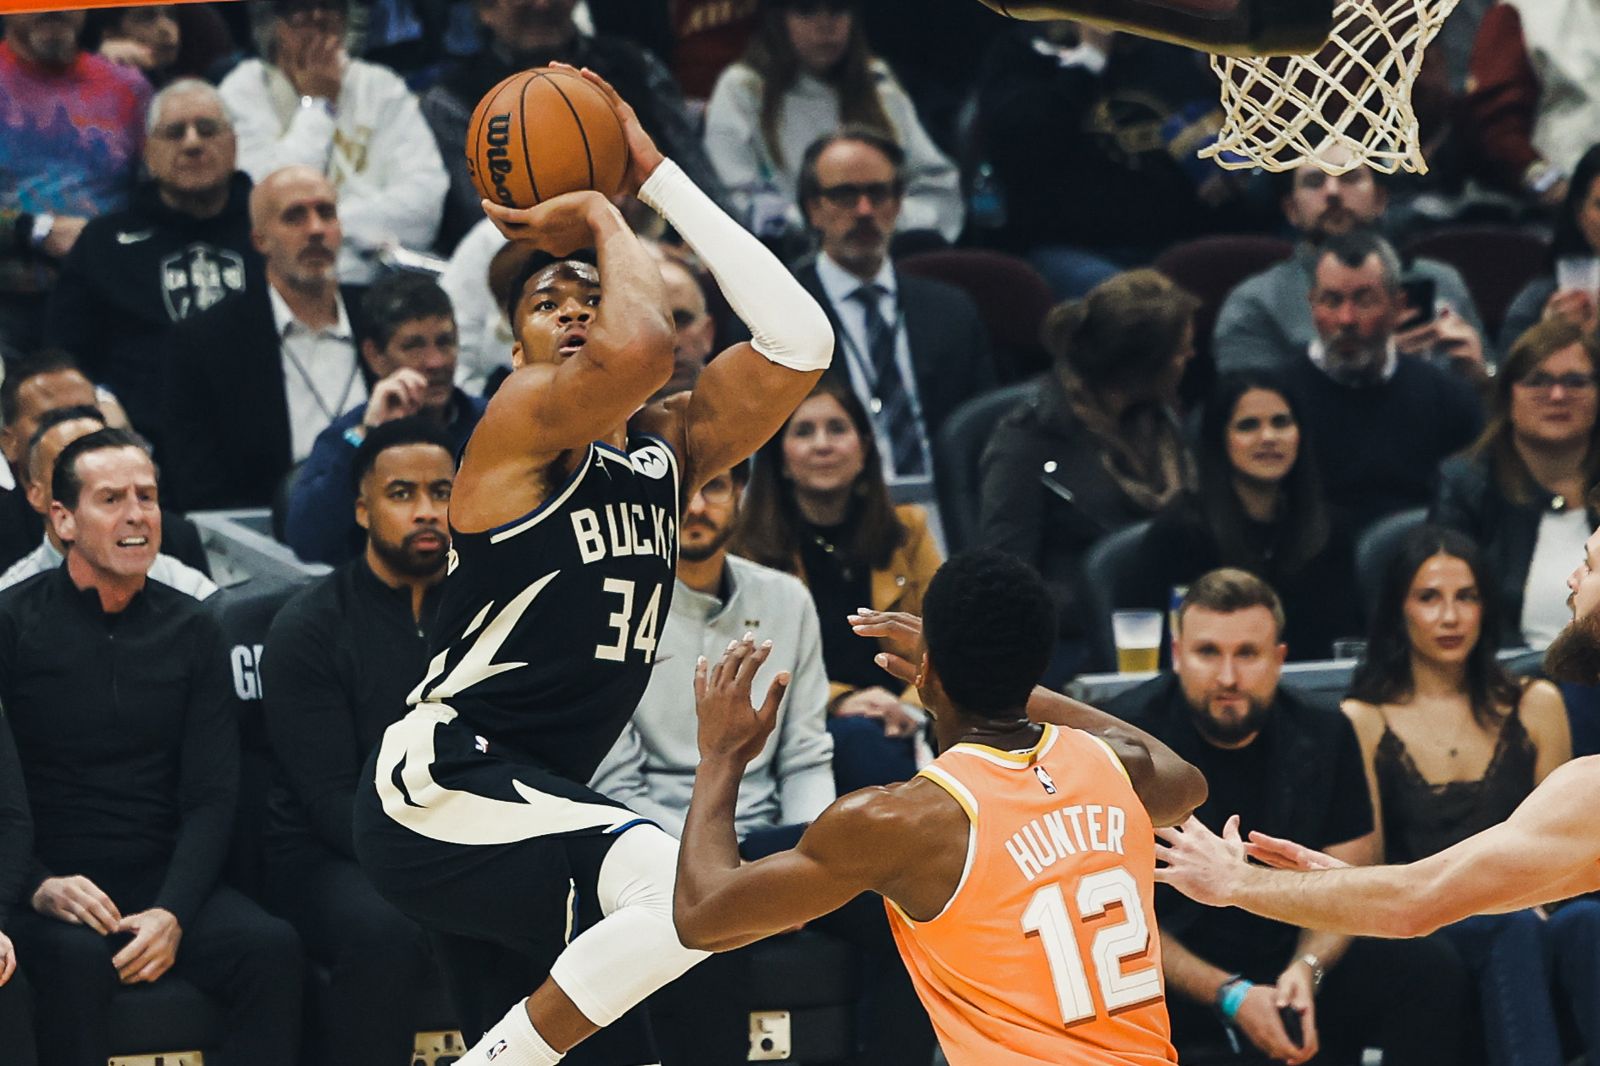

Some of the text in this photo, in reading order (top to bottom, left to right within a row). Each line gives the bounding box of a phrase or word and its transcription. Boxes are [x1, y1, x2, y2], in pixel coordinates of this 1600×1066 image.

[487, 112, 517, 208] Wilso
[594, 577, 663, 664] 34
[1004, 804, 1125, 882] HUNTER
[1019, 864, 1165, 1029] 12
